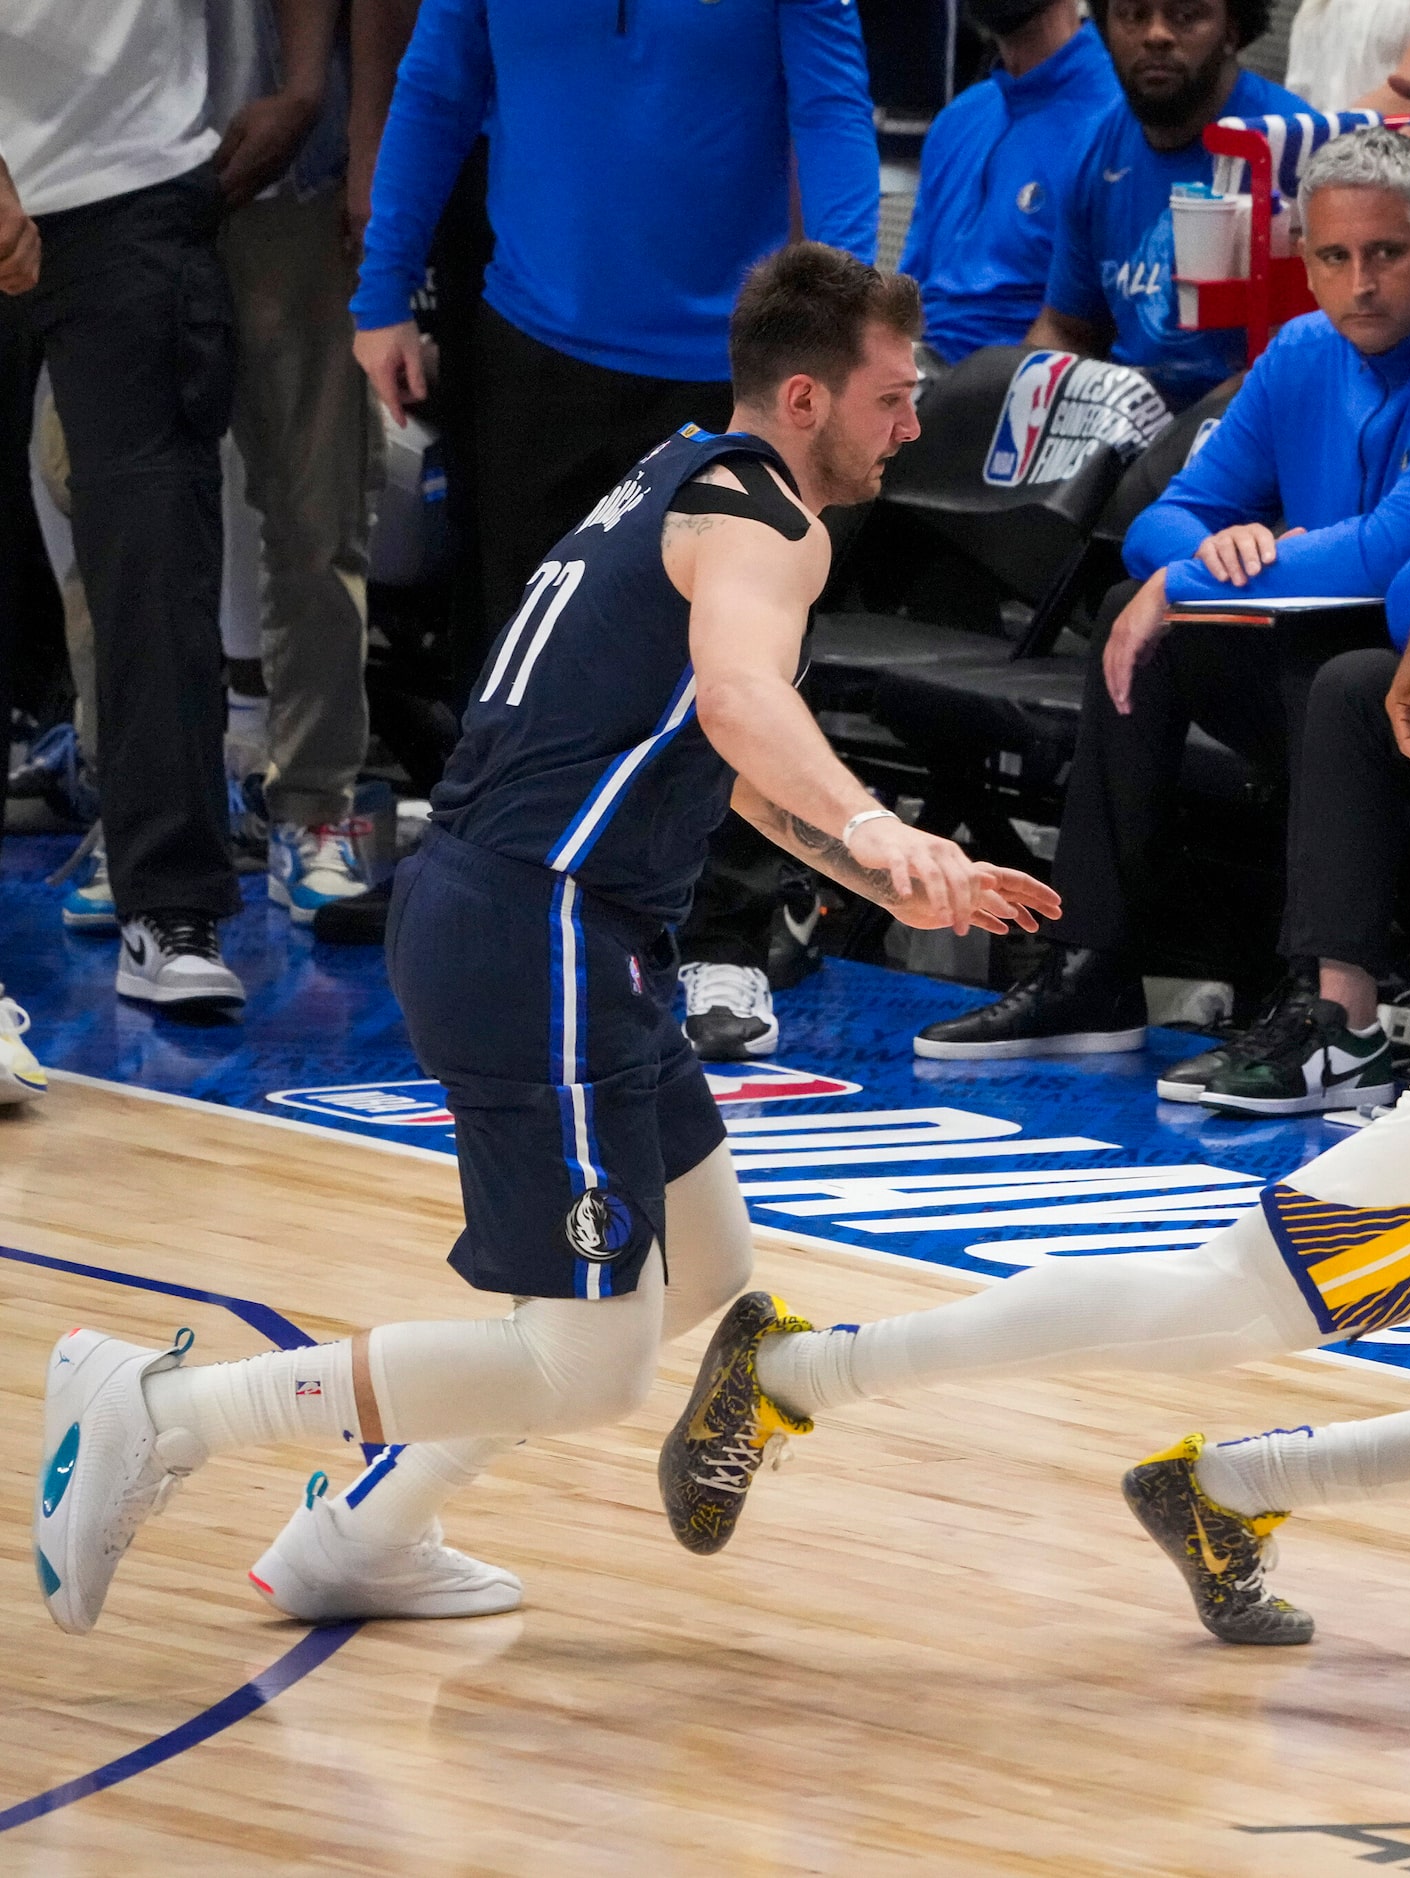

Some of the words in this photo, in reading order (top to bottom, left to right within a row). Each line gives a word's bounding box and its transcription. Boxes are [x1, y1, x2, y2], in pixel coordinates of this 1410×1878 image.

[1064, 359, 1174, 432] WESTERN
[1027, 437, 1101, 484] FINALS
[479, 560, 585, 706] 77
